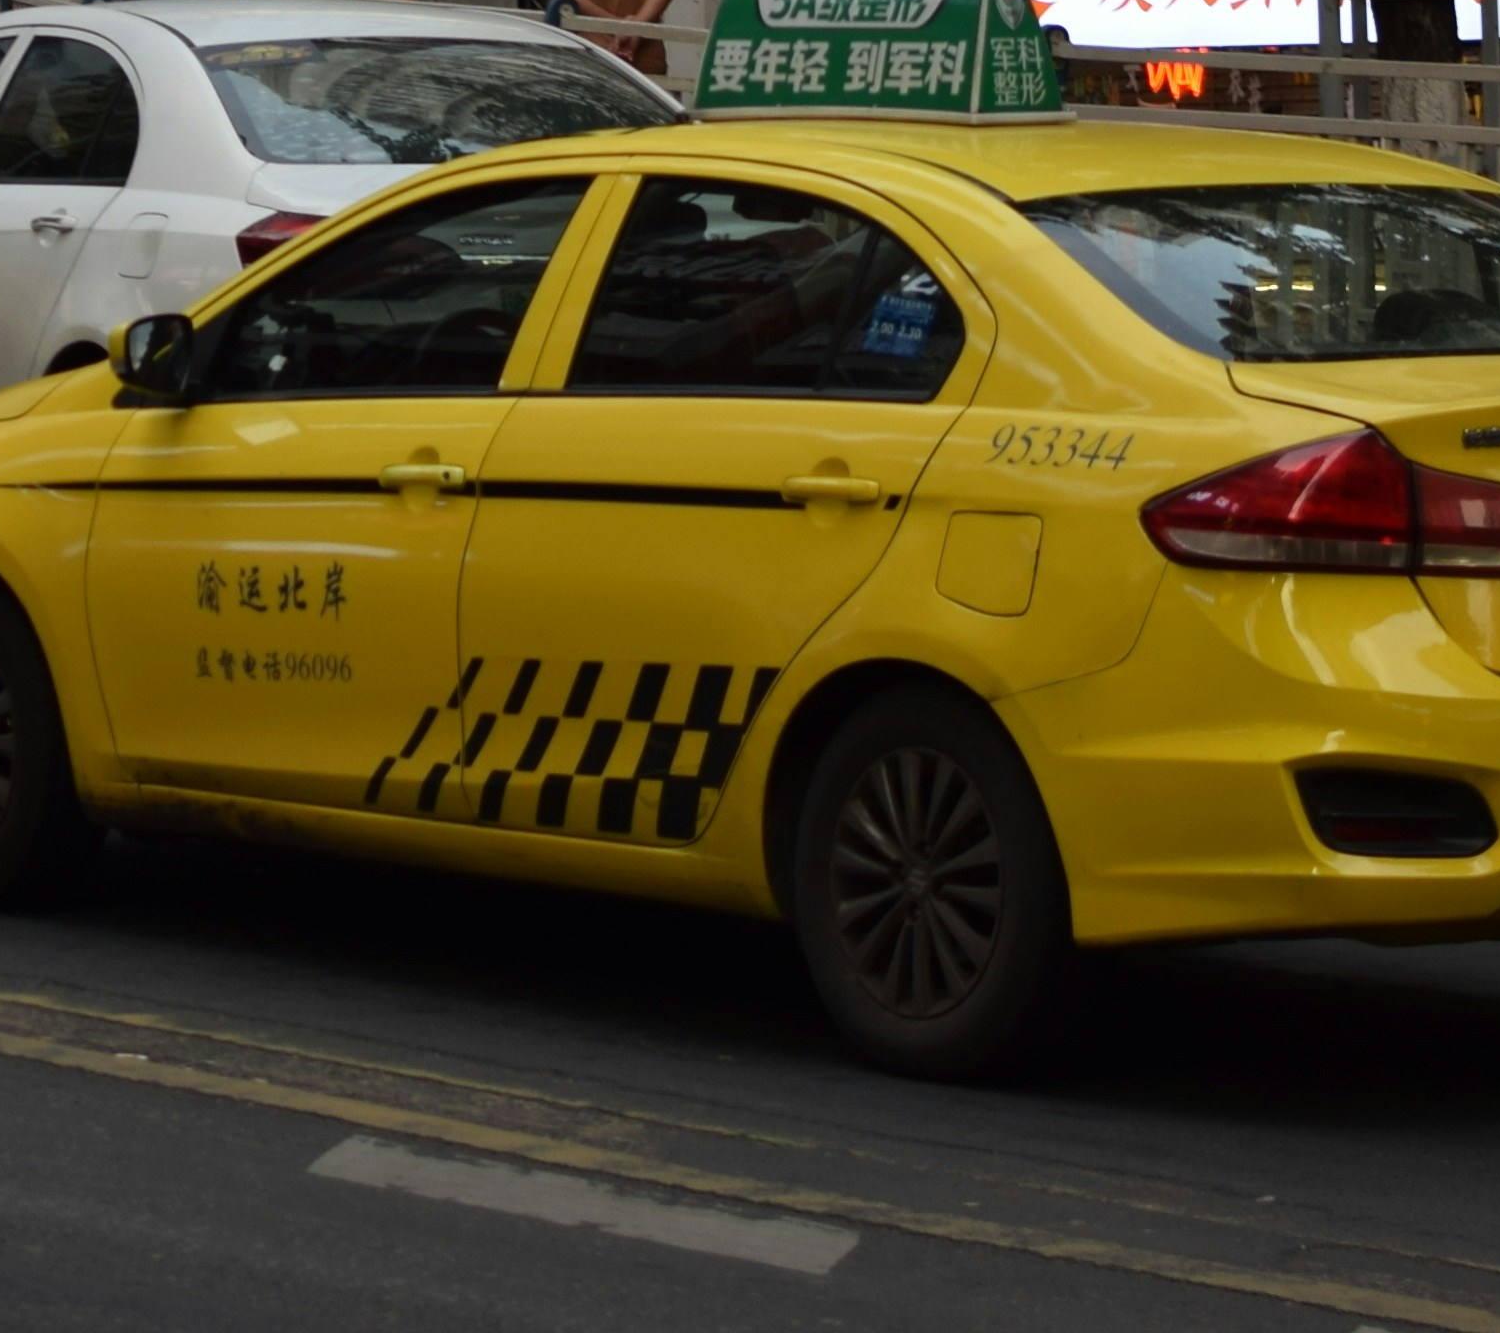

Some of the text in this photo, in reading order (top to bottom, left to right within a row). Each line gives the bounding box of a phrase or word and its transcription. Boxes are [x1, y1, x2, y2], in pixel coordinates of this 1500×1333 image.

[708, 37, 968, 96] 要年轻 到军科
[990, 37, 1045, 72] 军科
[992, 71, 1047, 107] 整形
[984, 422, 1135, 471] 953344
[197, 559, 347, 621] 渝运北岸
[196, 647, 353, 683] 监督电话96096
